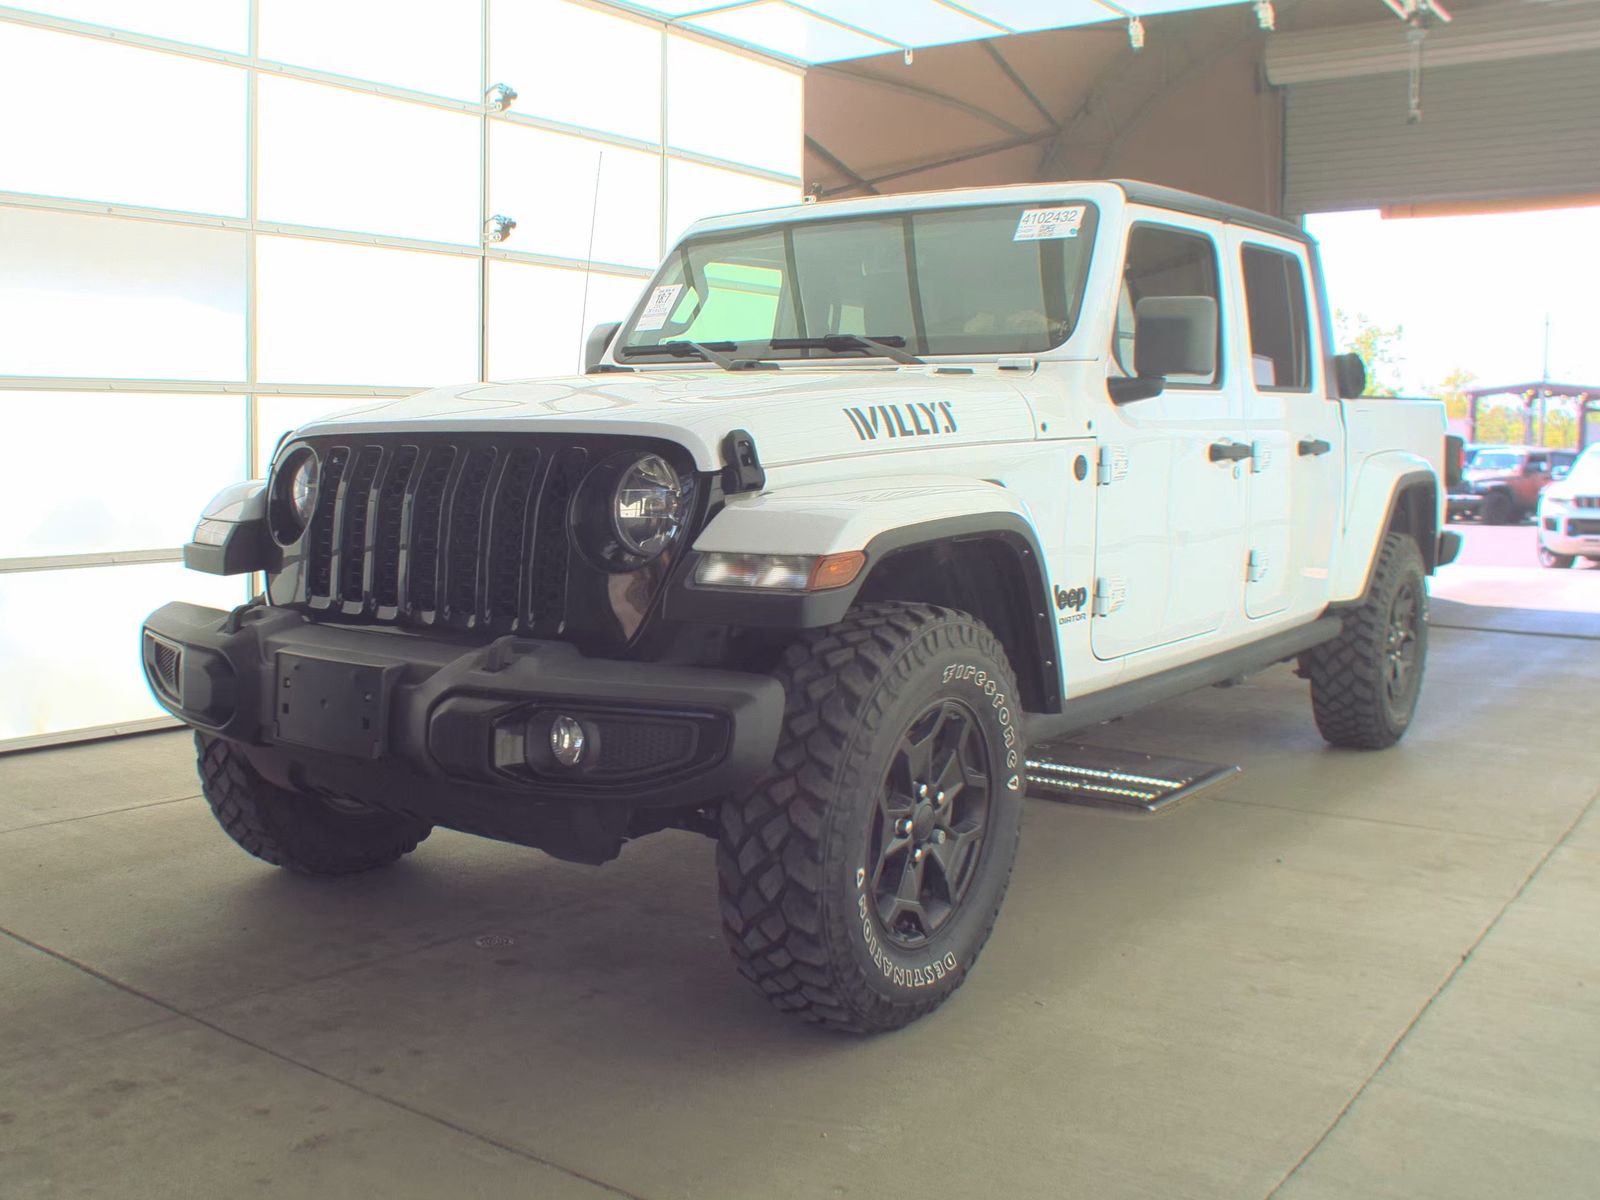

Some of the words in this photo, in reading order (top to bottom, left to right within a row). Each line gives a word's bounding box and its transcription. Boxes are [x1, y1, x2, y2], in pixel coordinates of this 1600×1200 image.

[1022, 209, 1078, 225] 4102432
[842, 401, 957, 440] WILLYS
[1058, 613, 1087, 625] DIATOR
[858, 894, 957, 987] DESTINATION
